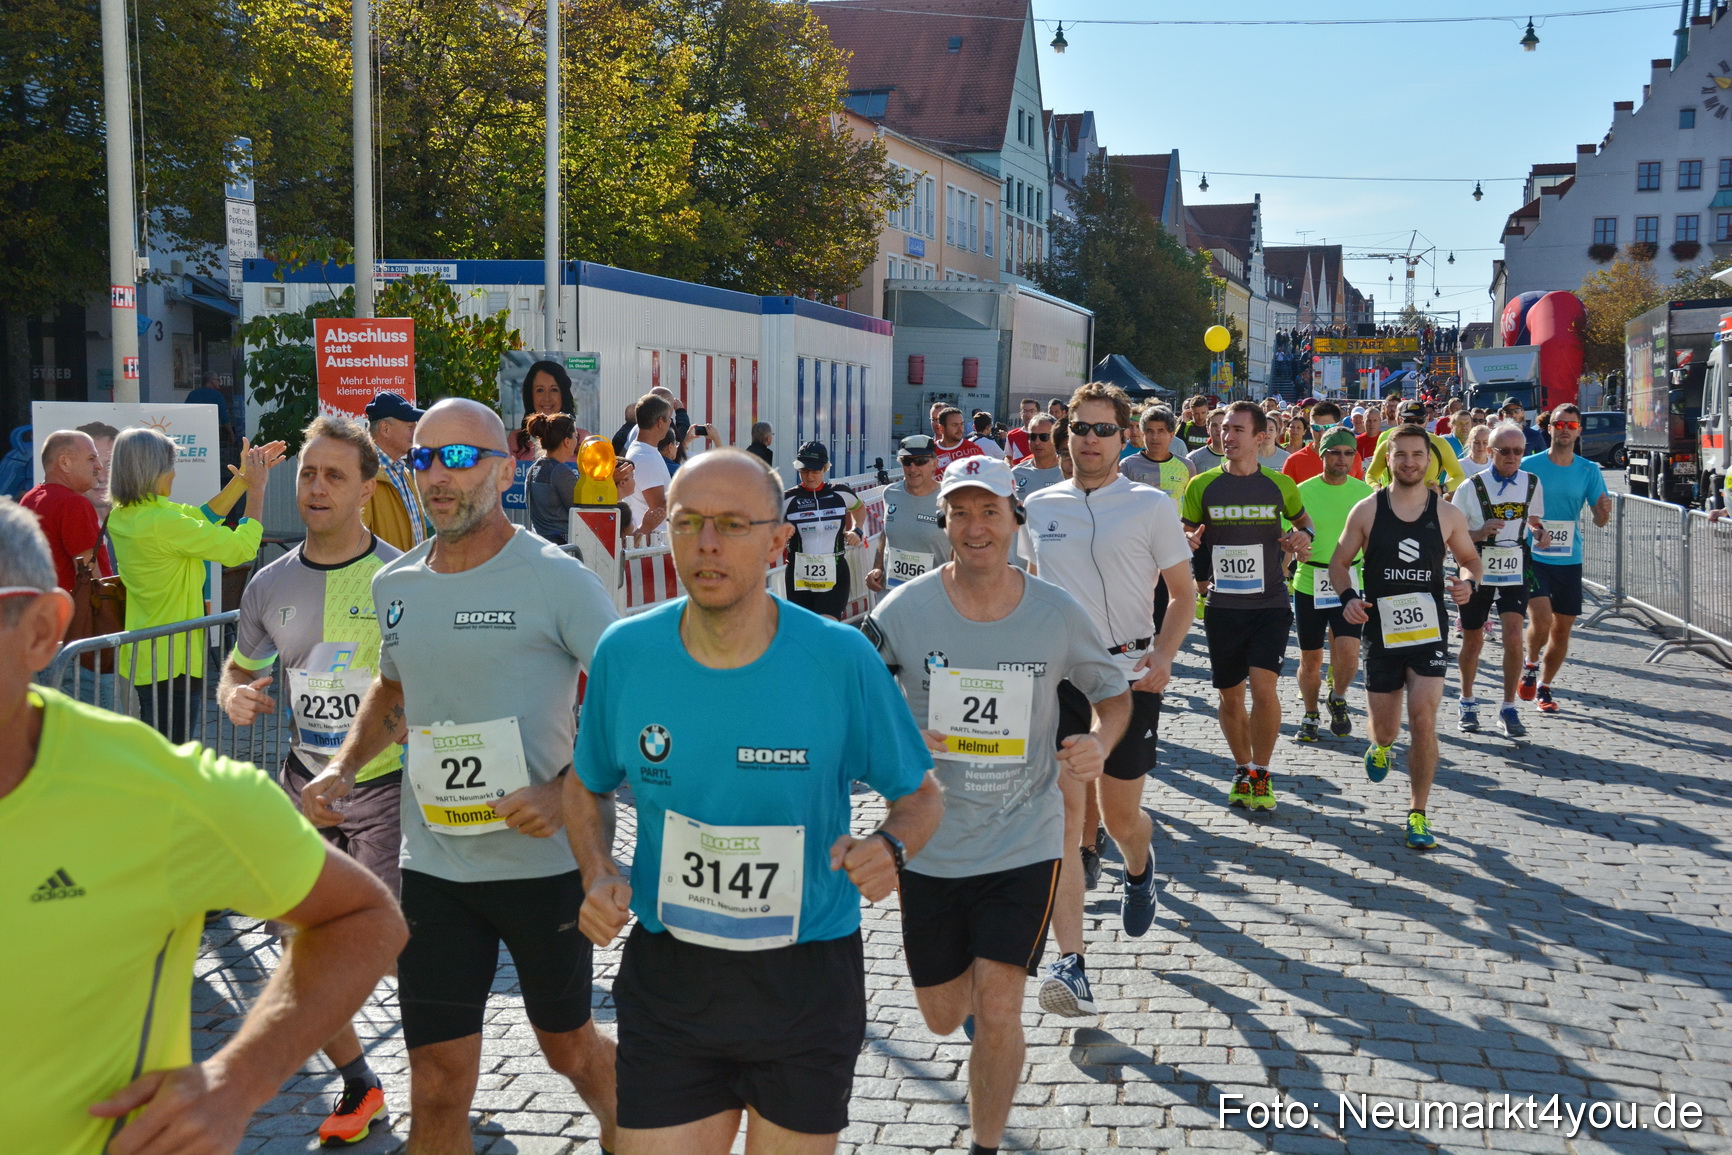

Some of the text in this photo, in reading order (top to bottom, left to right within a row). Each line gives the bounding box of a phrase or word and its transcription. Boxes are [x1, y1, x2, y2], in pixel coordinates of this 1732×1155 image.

[229, 214, 255, 227] Parkschein
[231, 227, 253, 238] werktags
[155, 320, 164, 341] 3
[325, 328, 408, 343] Abschluss
[325, 344, 352, 354] statt
[1347, 341, 1384, 350] START
[325, 355, 409, 368] Ausschluss!
[33, 367, 72, 379] STREB
[340, 376, 406, 385] Mehr Lehrer für
[337, 387, 406, 396] kleinere Klassen.
[1188, 435, 1209, 444] BOC
[951, 448, 980, 459] raum
[966, 461, 980, 475] R
[506, 493, 526, 503] CSU
[1209, 506, 1276, 519] BOCK
[894, 560, 926, 576] 3056
[1220, 558, 1256, 574] 3102
[1488, 558, 1518, 570] 2140
[804, 565, 827, 577] 123
[1384, 568, 1432, 582] SINGER
[455, 611, 514, 624] BOCK
[1392, 607, 1424, 625] 336
[999, 663, 1046, 673] BOCK
[309, 679, 344, 688] BOCK
[960, 678, 1004, 689] BOCK
[301, 694, 360, 719] 2230
[962, 696, 998, 724] 24
[643, 724, 670, 740] BMW
[314, 734, 345, 746] Thoma
[433, 734, 483, 748] BOCK
[958, 740, 999, 754] Helmut
[737, 748, 808, 764] BOCK
[441, 756, 486, 790] 22
[641, 767, 671, 779] PARTL
[642, 777, 672, 786] Neumarkt
[964, 781, 1010, 792] Stadtlauf
[459, 792, 494, 800] Neumarkt
[445, 808, 498, 824] Thomas
[701, 833, 760, 850] BOCK
[682, 852, 779, 899] 3147
[31, 887, 86, 902] adidas
[688, 894, 757, 912] PARTL Neumarkt
